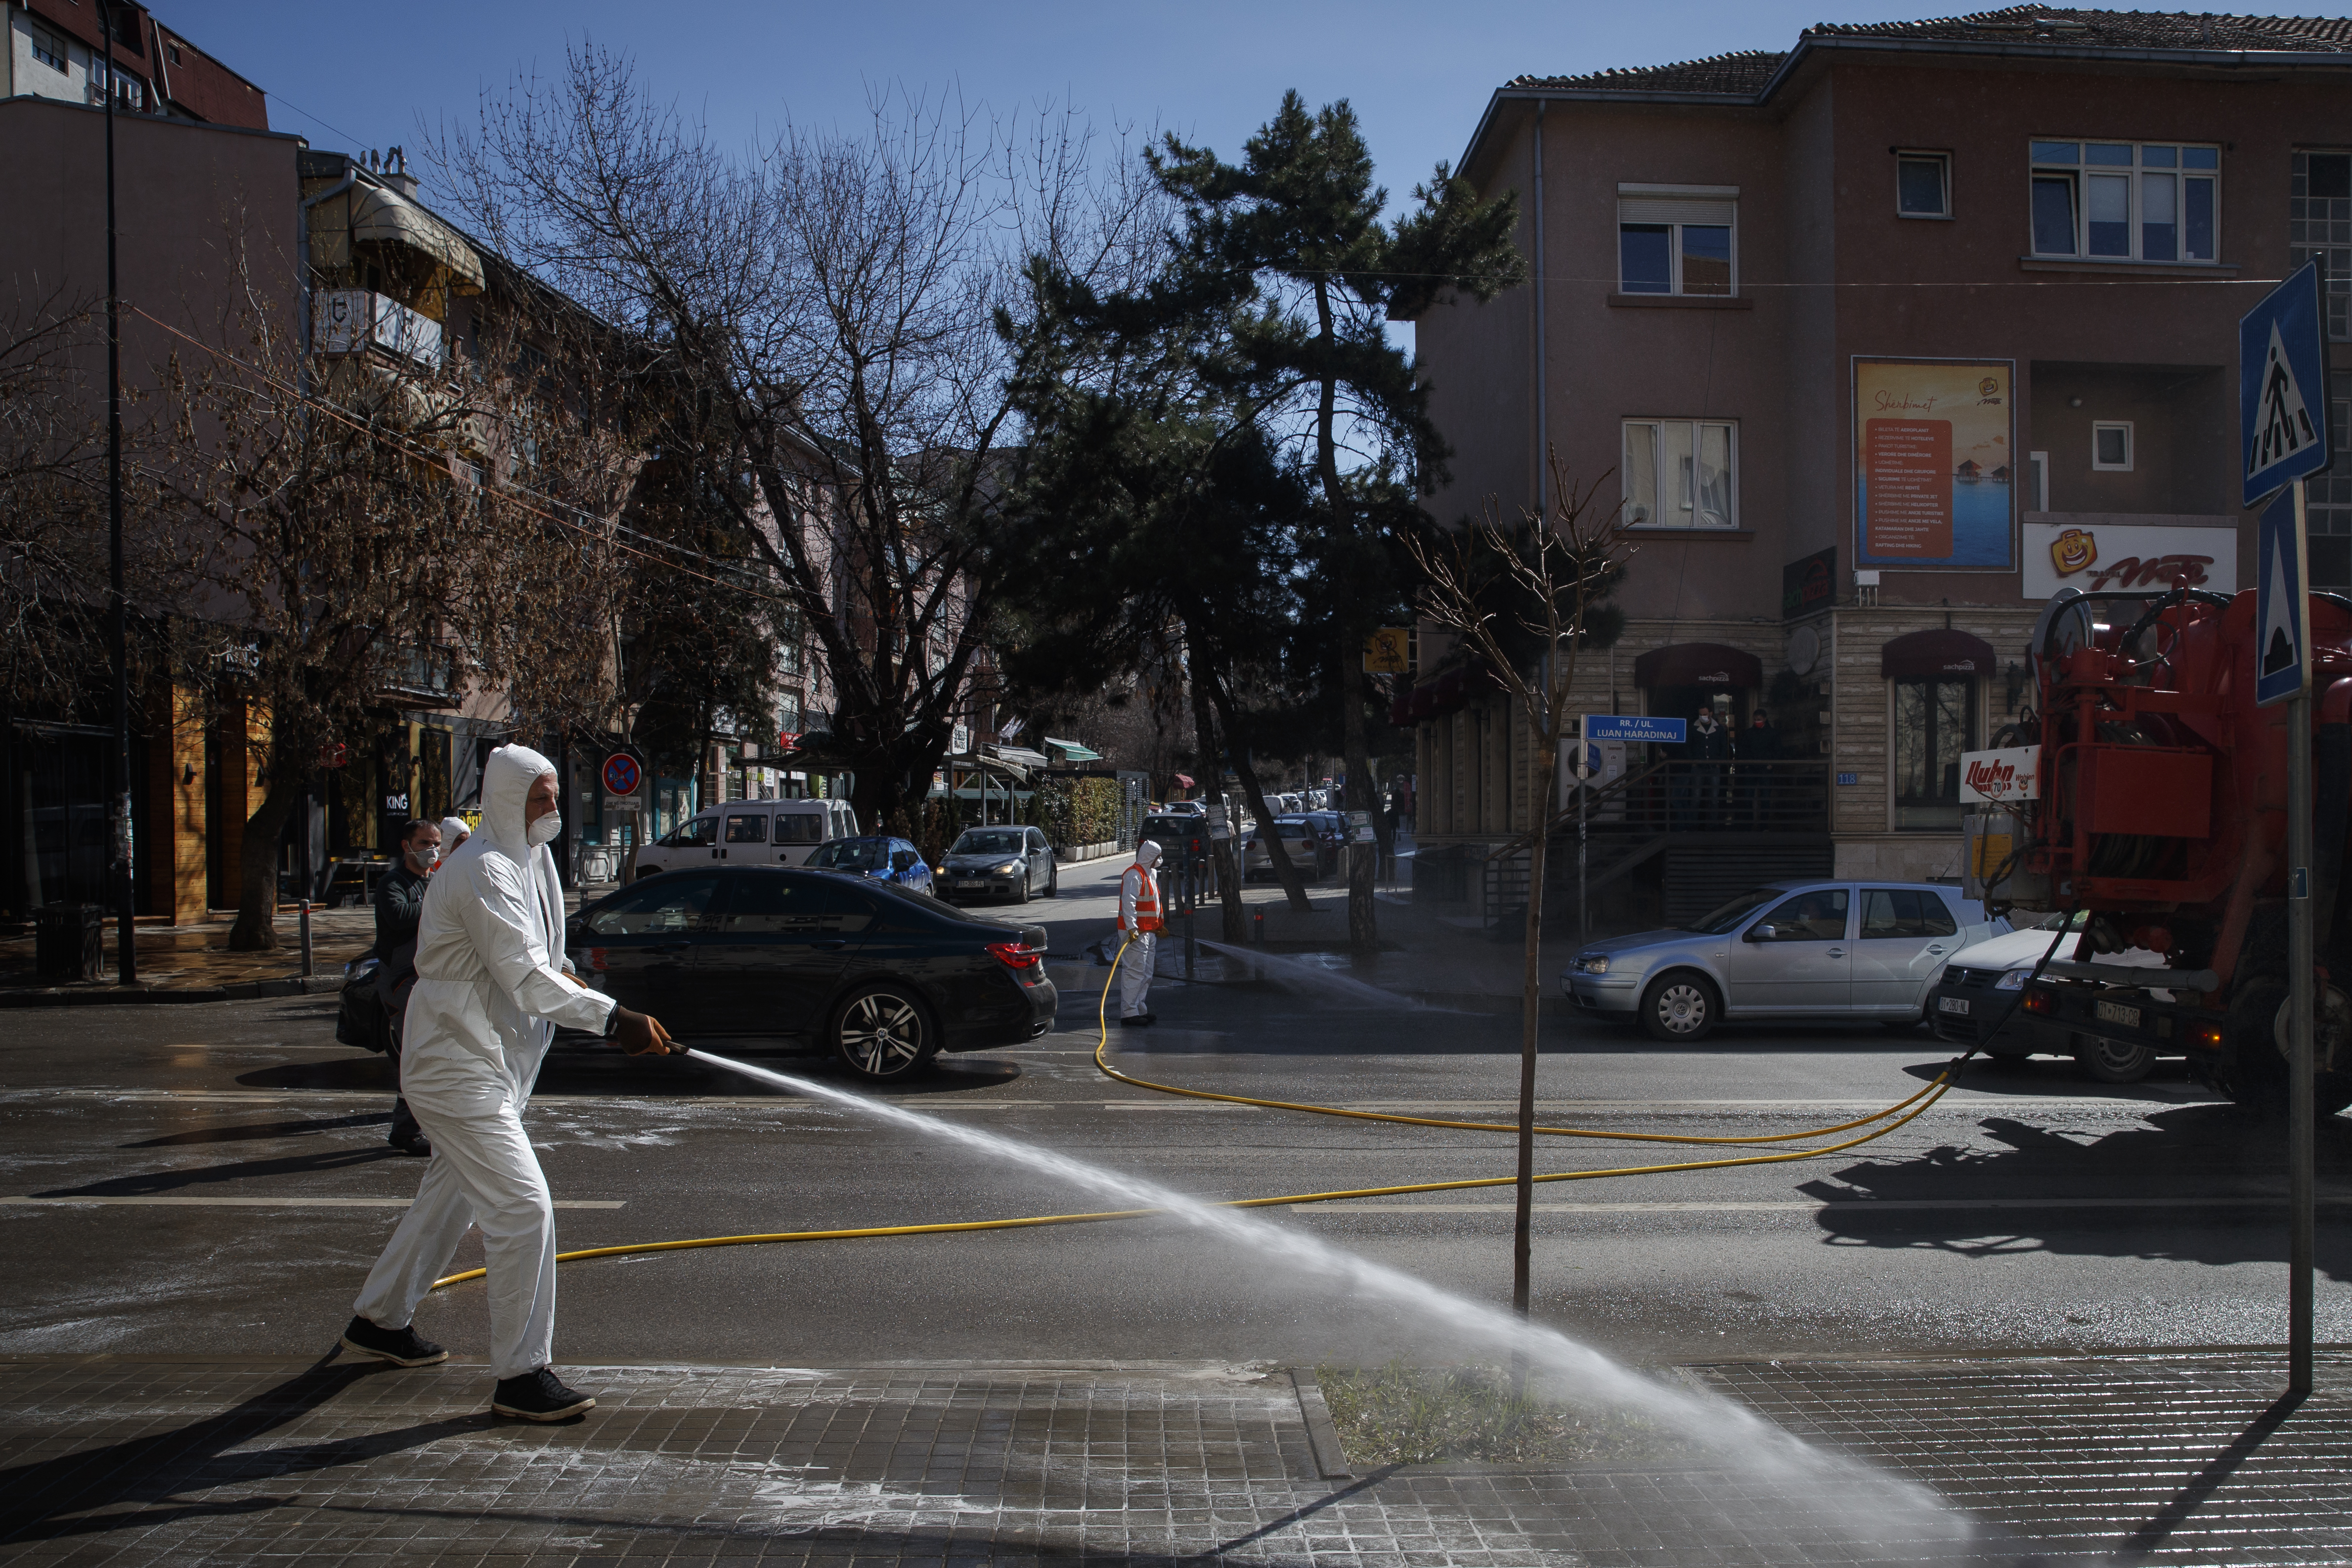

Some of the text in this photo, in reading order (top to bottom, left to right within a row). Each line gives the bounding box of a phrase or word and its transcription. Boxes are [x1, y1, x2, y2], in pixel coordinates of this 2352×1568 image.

[1875, 390, 1937, 412] Shërbimet
[1597, 729, 1677, 740] LUAN HARADINAJ
[1839, 774, 1855, 784] 118
[1994, 783, 2001, 792] 70
[386, 792, 408, 810] KING
